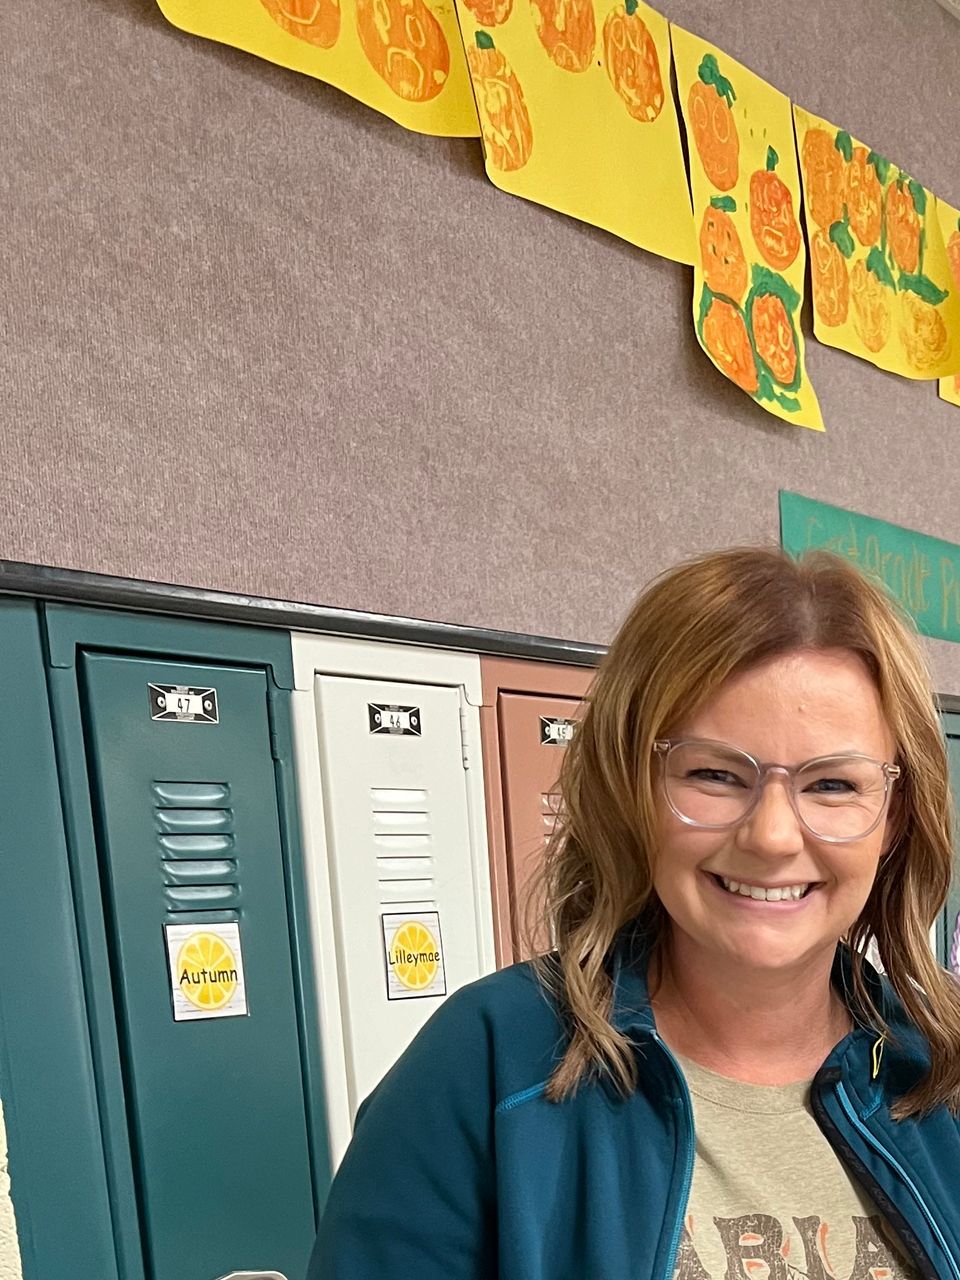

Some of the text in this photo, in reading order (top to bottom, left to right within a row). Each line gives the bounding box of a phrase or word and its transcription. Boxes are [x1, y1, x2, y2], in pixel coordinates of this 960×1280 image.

[177, 697, 191, 713] 47
[389, 714, 401, 729] 46
[388, 949, 441, 968] Lilleymae
[180, 968, 238, 985] Autumn
